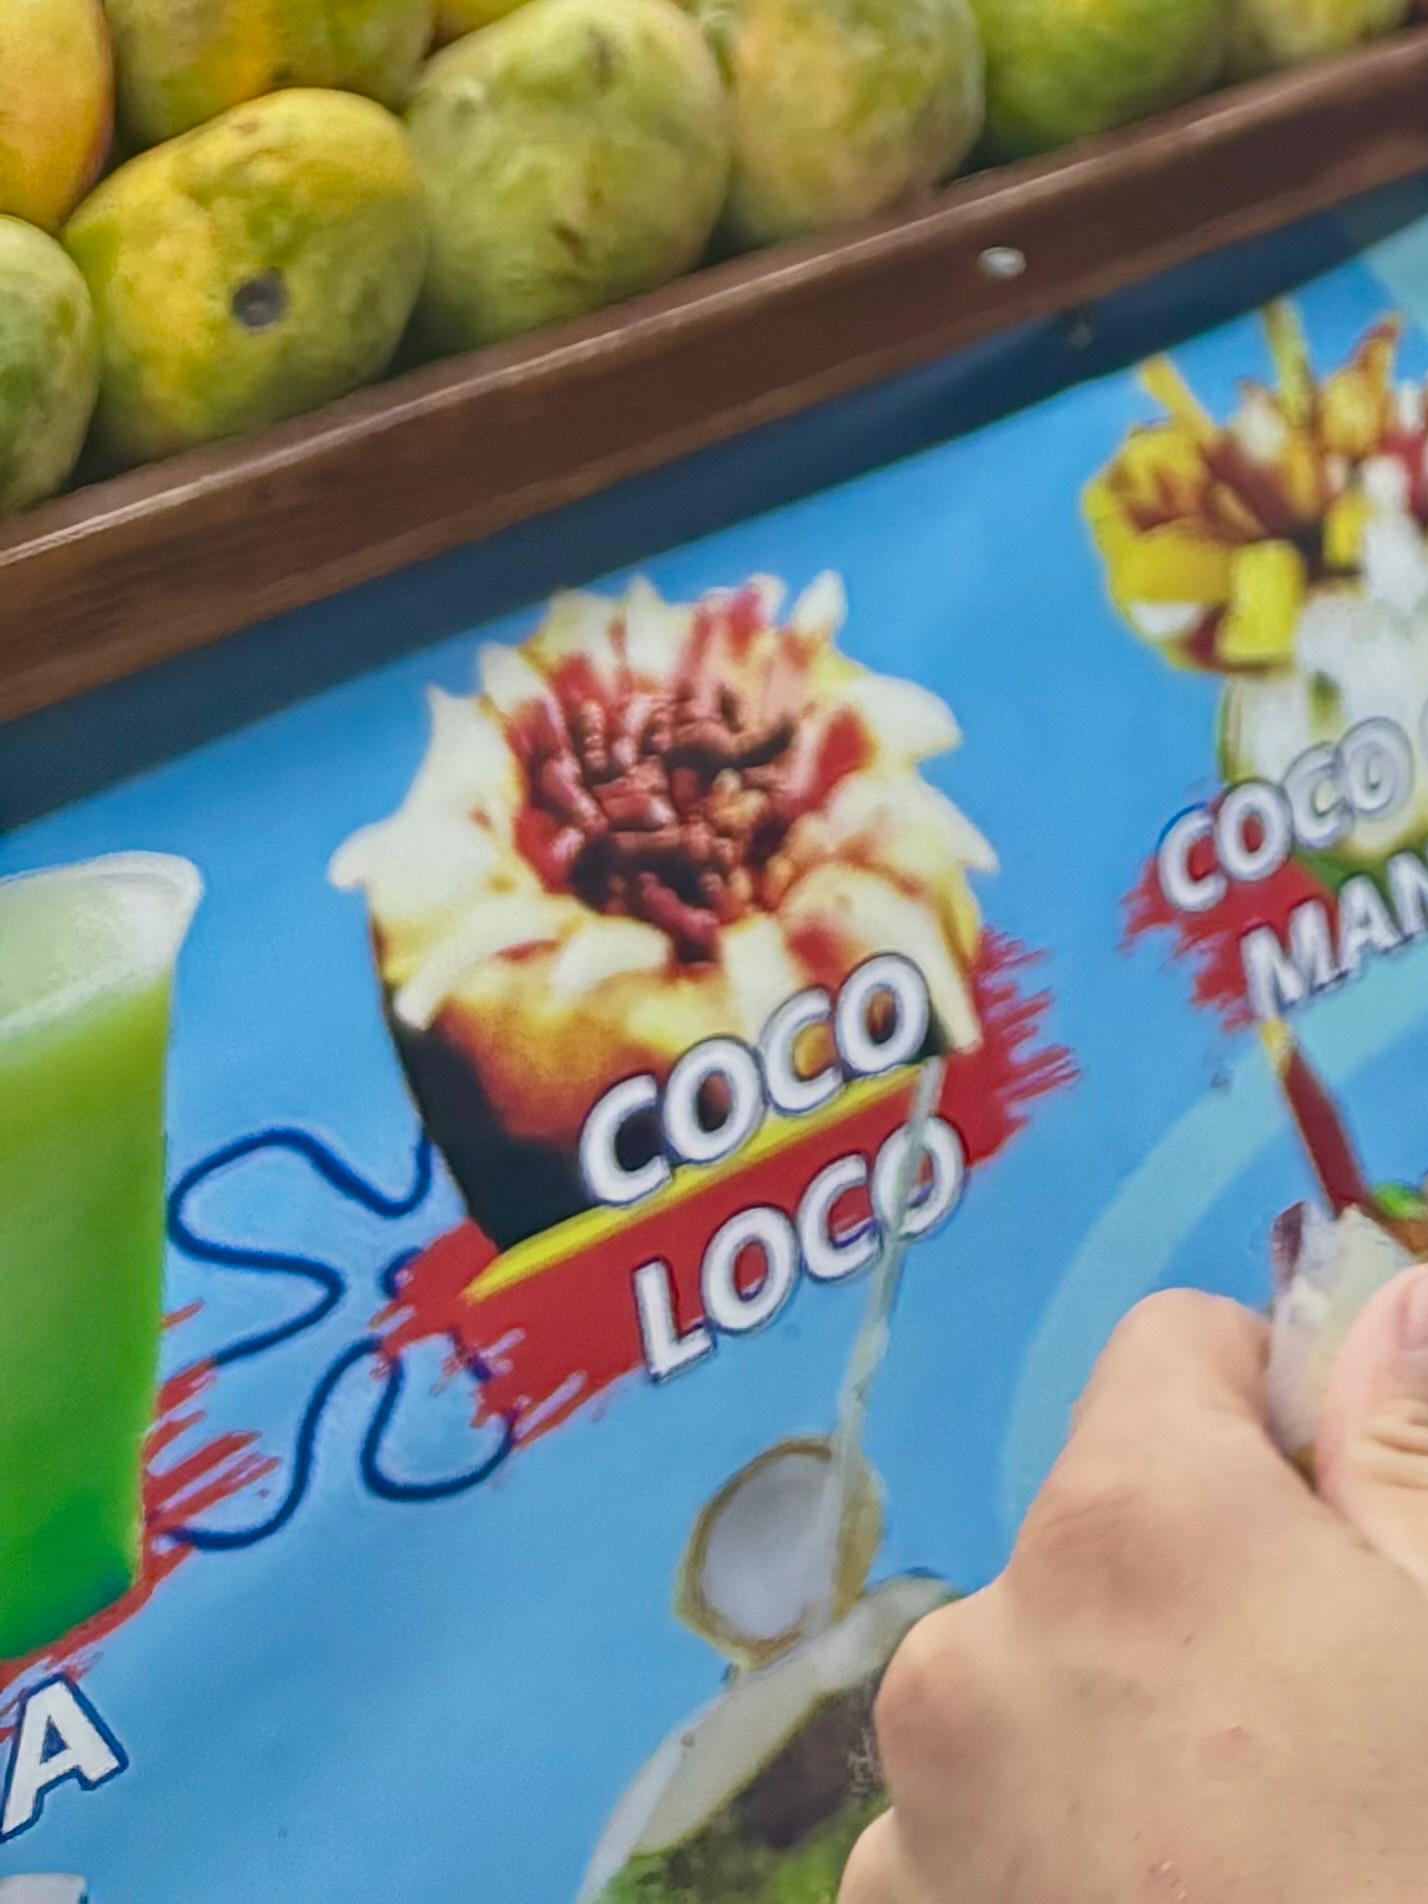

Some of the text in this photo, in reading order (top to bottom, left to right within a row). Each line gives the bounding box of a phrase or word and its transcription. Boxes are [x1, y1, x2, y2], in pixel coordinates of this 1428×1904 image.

[1158, 717, 1413, 913] COCO
[579, 953, 929, 1206] COCO
[632, 1116, 968, 1382] LOCO
